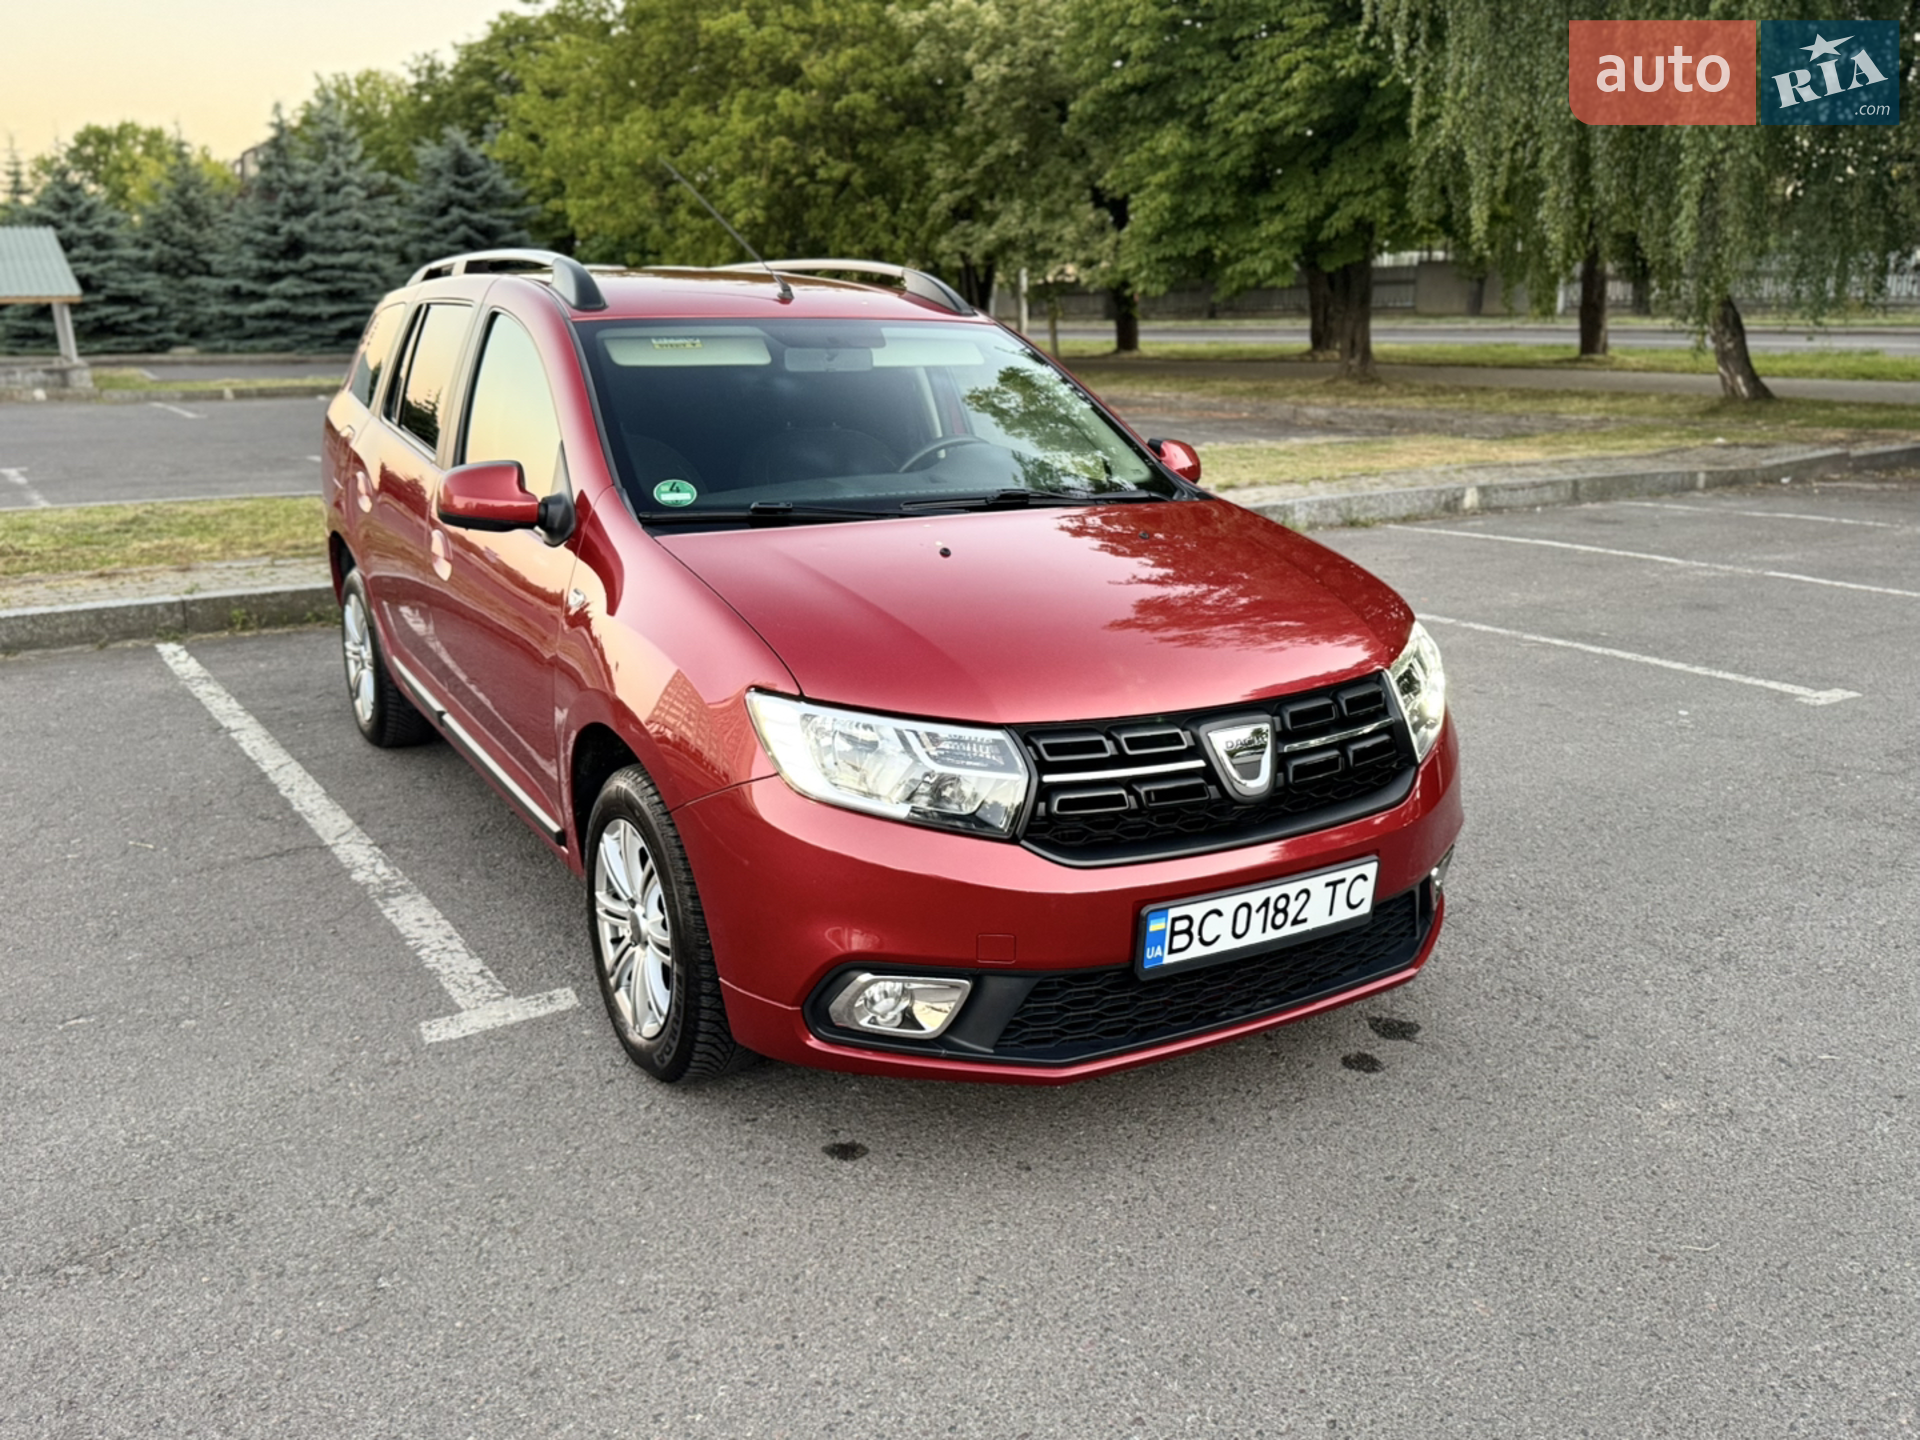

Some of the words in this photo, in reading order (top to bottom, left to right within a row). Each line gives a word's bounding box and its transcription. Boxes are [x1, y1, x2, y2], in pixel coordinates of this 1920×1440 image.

[1167, 908, 1224, 955] BC
[1231, 888, 1311, 940] 0182
[1324, 873, 1369, 917] TC
[1146, 945, 1163, 960] UA
